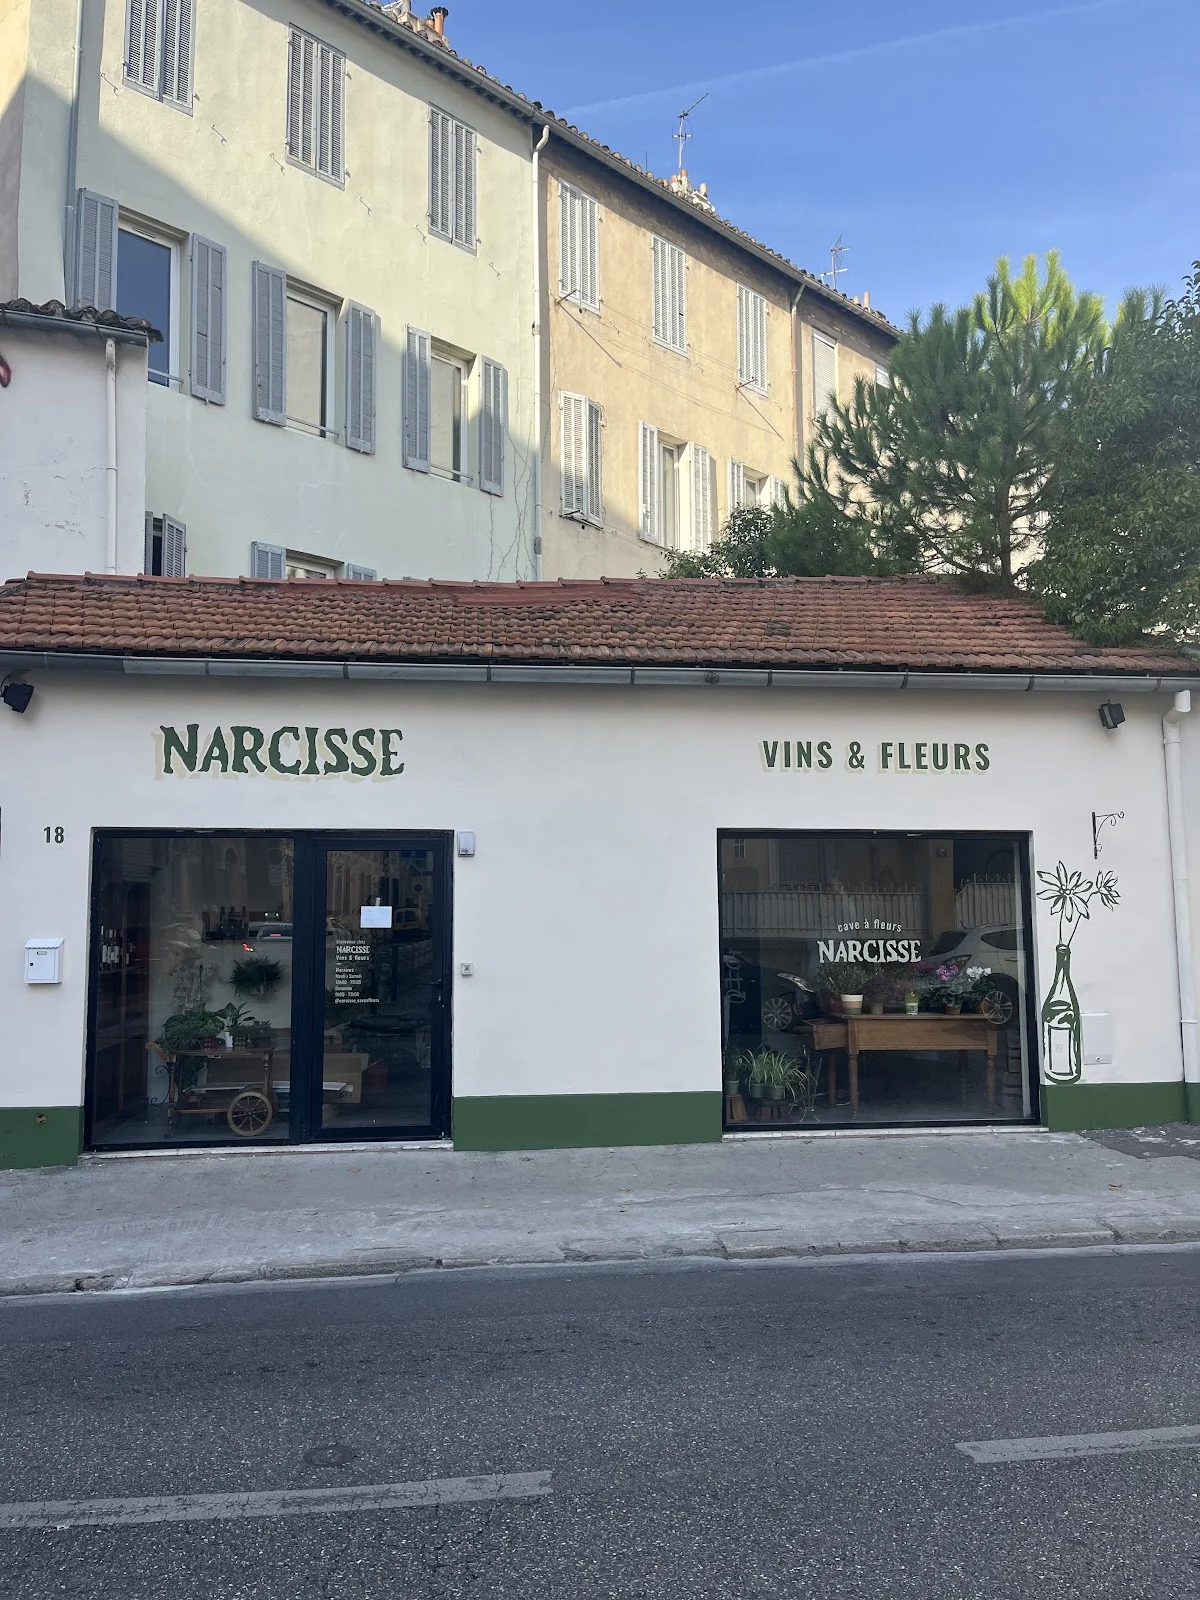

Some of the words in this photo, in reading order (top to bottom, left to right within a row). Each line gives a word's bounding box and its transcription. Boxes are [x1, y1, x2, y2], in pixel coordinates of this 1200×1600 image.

[159, 723, 405, 776] NARCISSE
[762, 740, 833, 769] VINS
[848, 741, 865, 769] &
[880, 742, 990, 771] FLEURS
[43, 826, 65, 844] 18
[837, 921, 860, 933] cave
[864, 918, 870, 929] à
[873, 918, 902, 933] fleurs
[816, 939, 922, 963] NARCISSE
